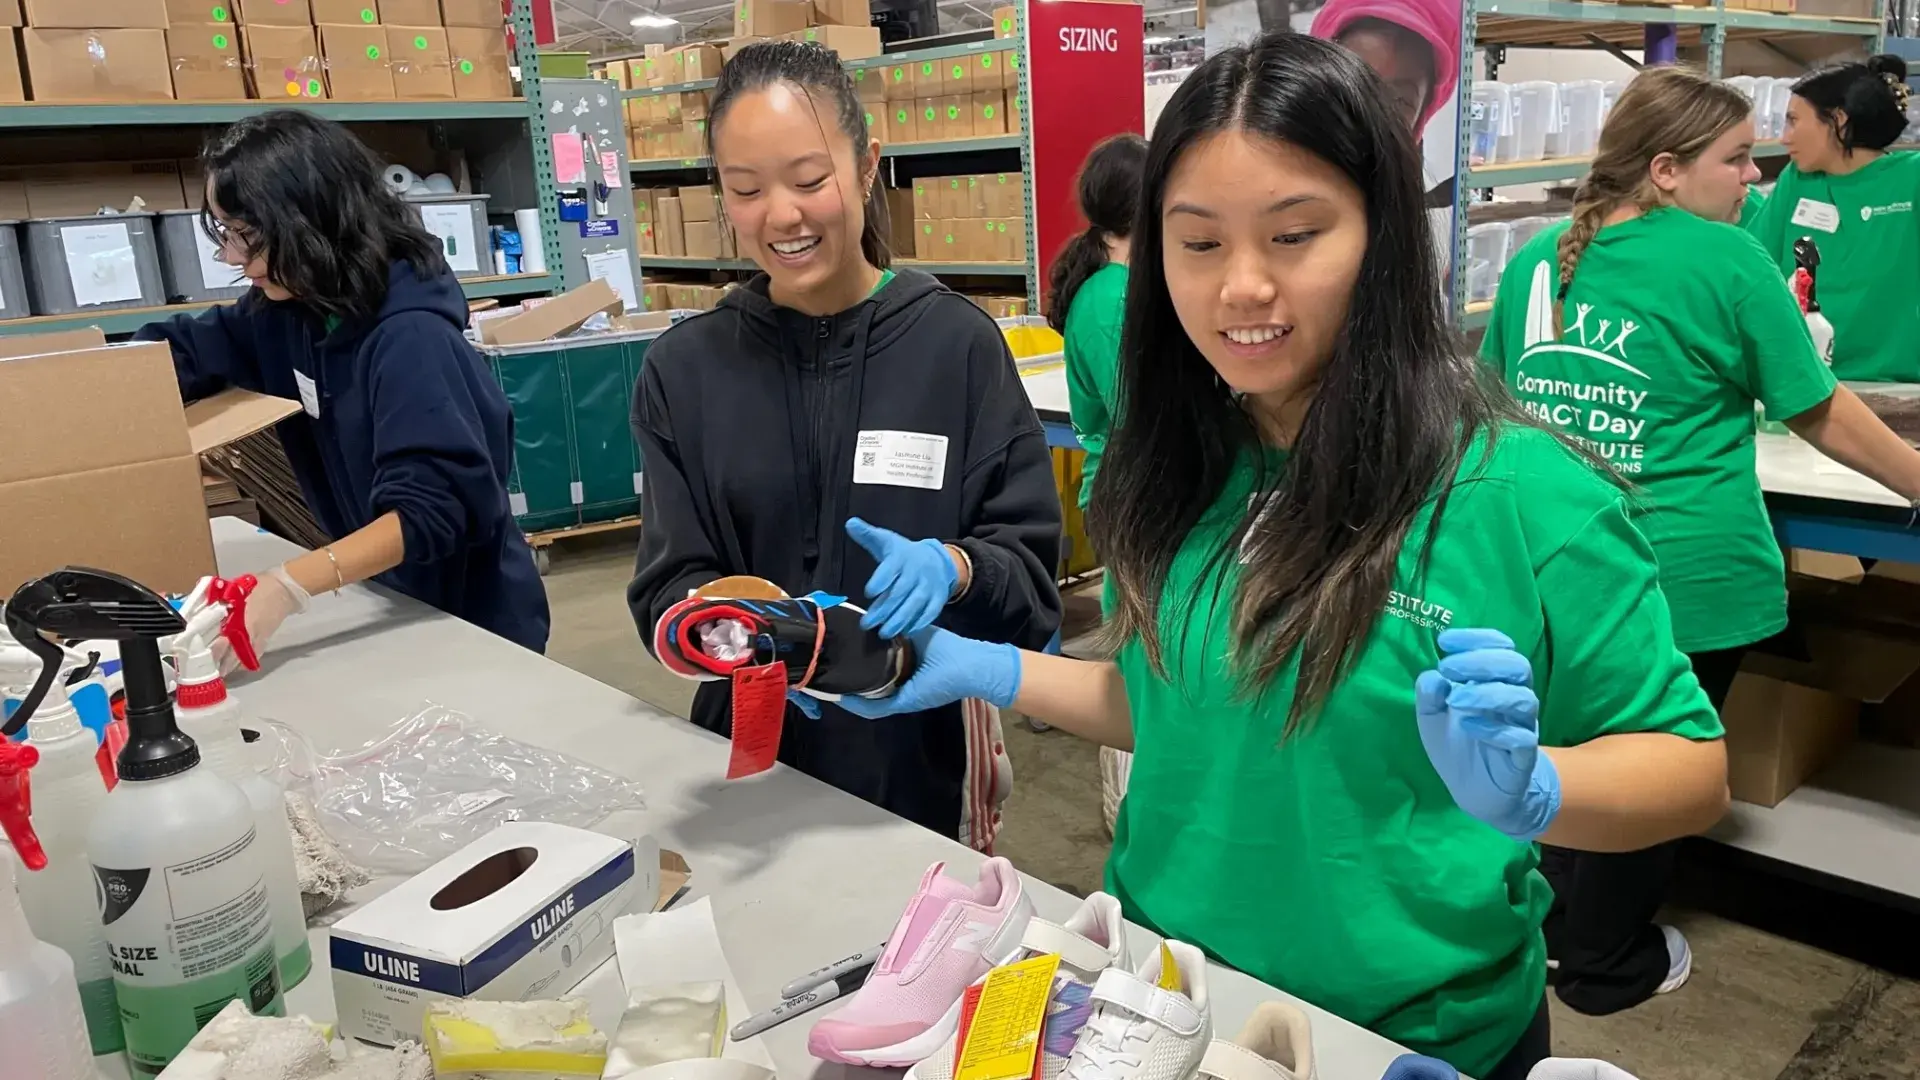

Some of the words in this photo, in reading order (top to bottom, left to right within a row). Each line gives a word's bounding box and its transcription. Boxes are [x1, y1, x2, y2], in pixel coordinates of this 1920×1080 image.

[1059, 27, 1118, 52] SIZING
[1516, 370, 1649, 413] Community
[1588, 409, 1646, 441] Day
[1387, 590, 1454, 625] STITUTE
[530, 892, 575, 941] ULINE
[120, 946, 158, 961] SIZE
[364, 951, 420, 982] ULINE
[786, 991, 818, 1010] Sharpie
